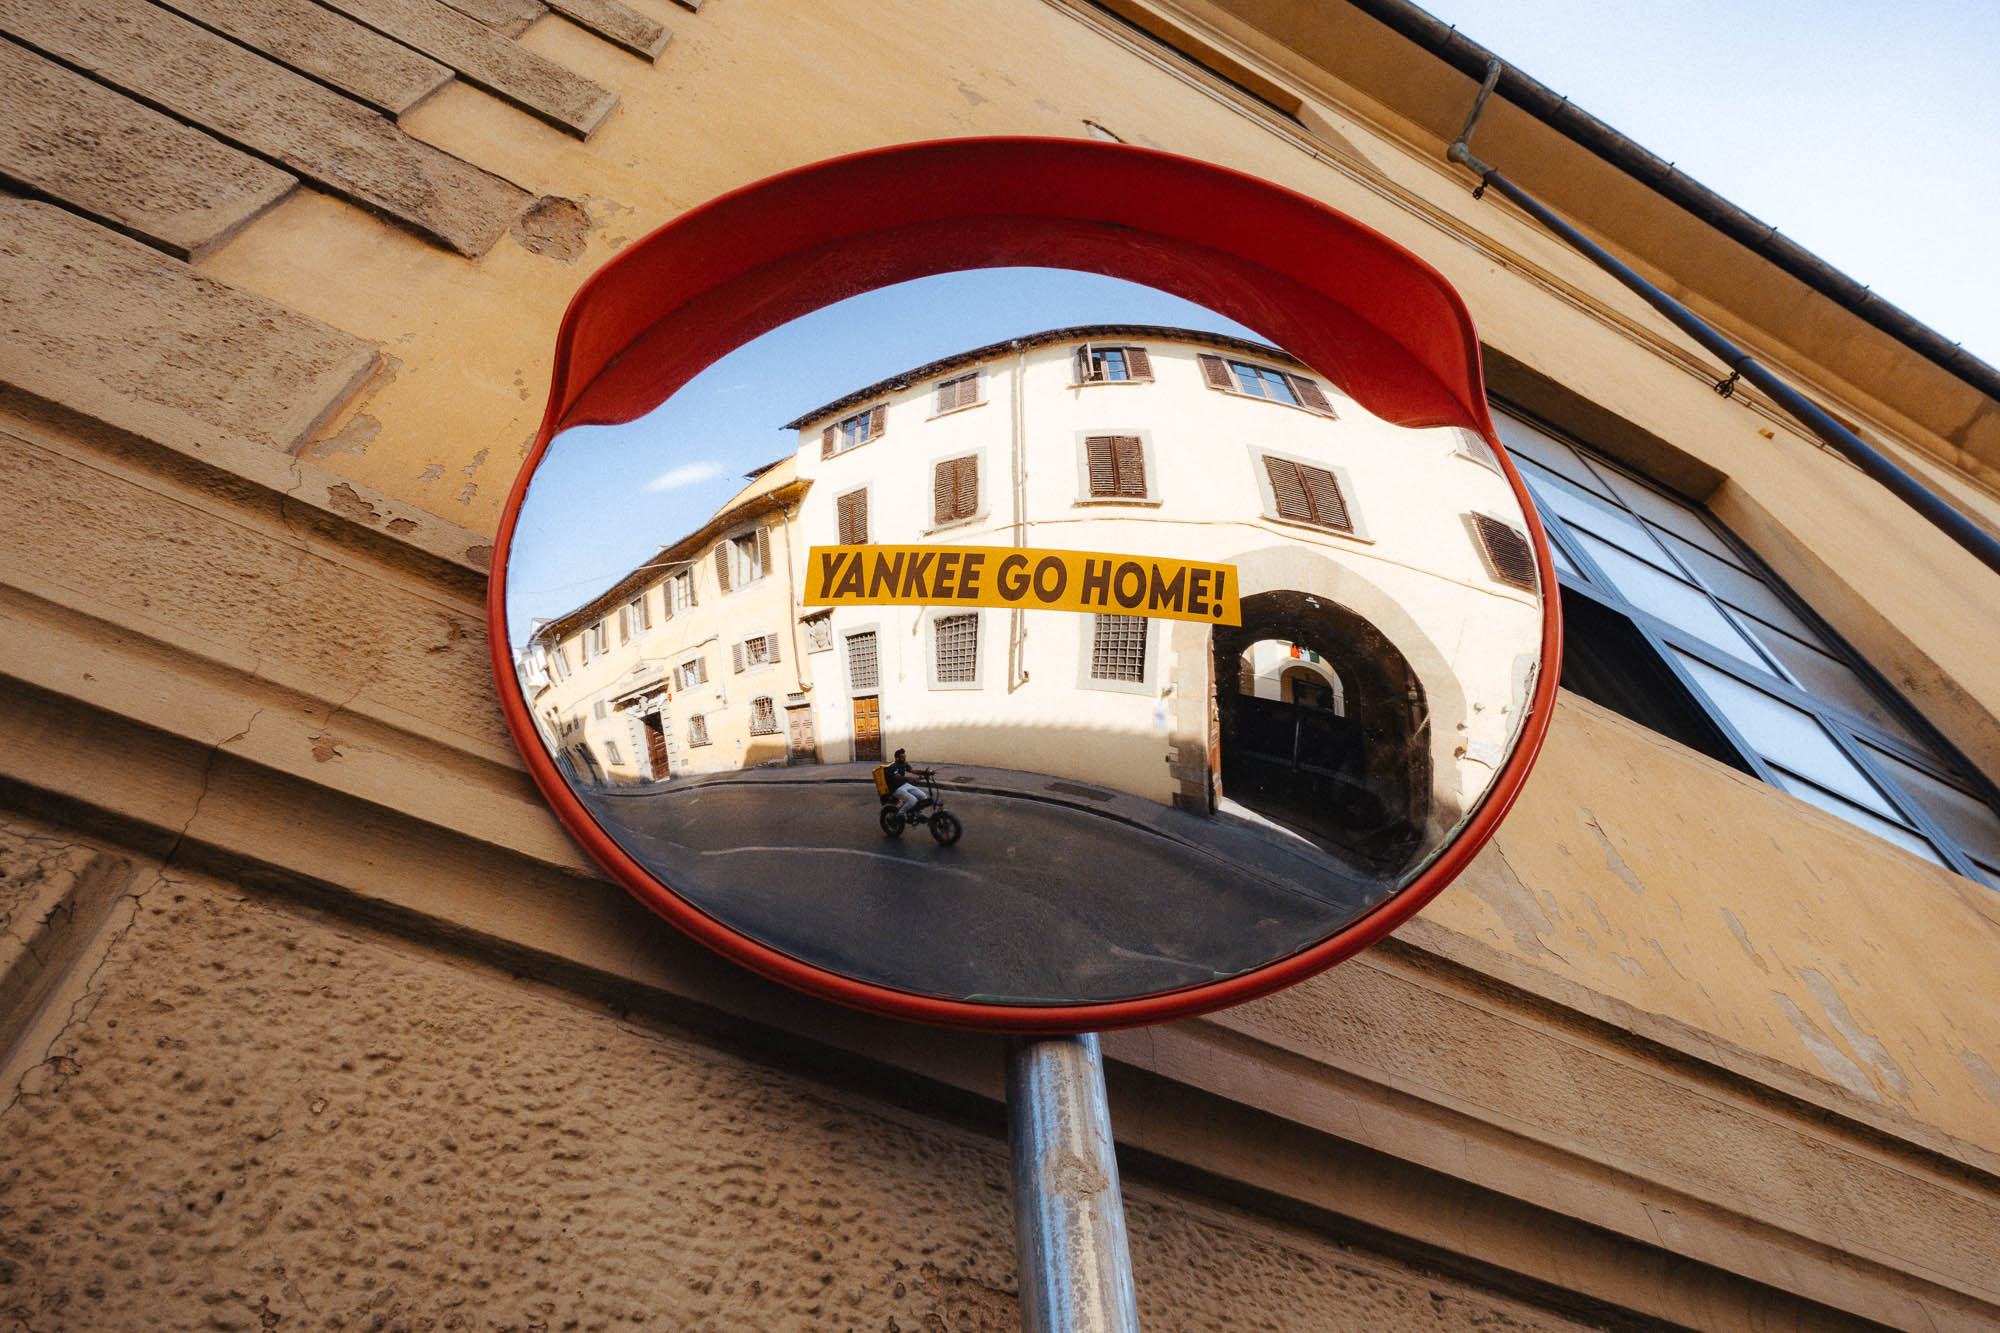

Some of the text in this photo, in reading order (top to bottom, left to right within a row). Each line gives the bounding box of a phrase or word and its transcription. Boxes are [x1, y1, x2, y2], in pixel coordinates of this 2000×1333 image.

[819, 552, 1226, 618] YANKEE GO HOME!
